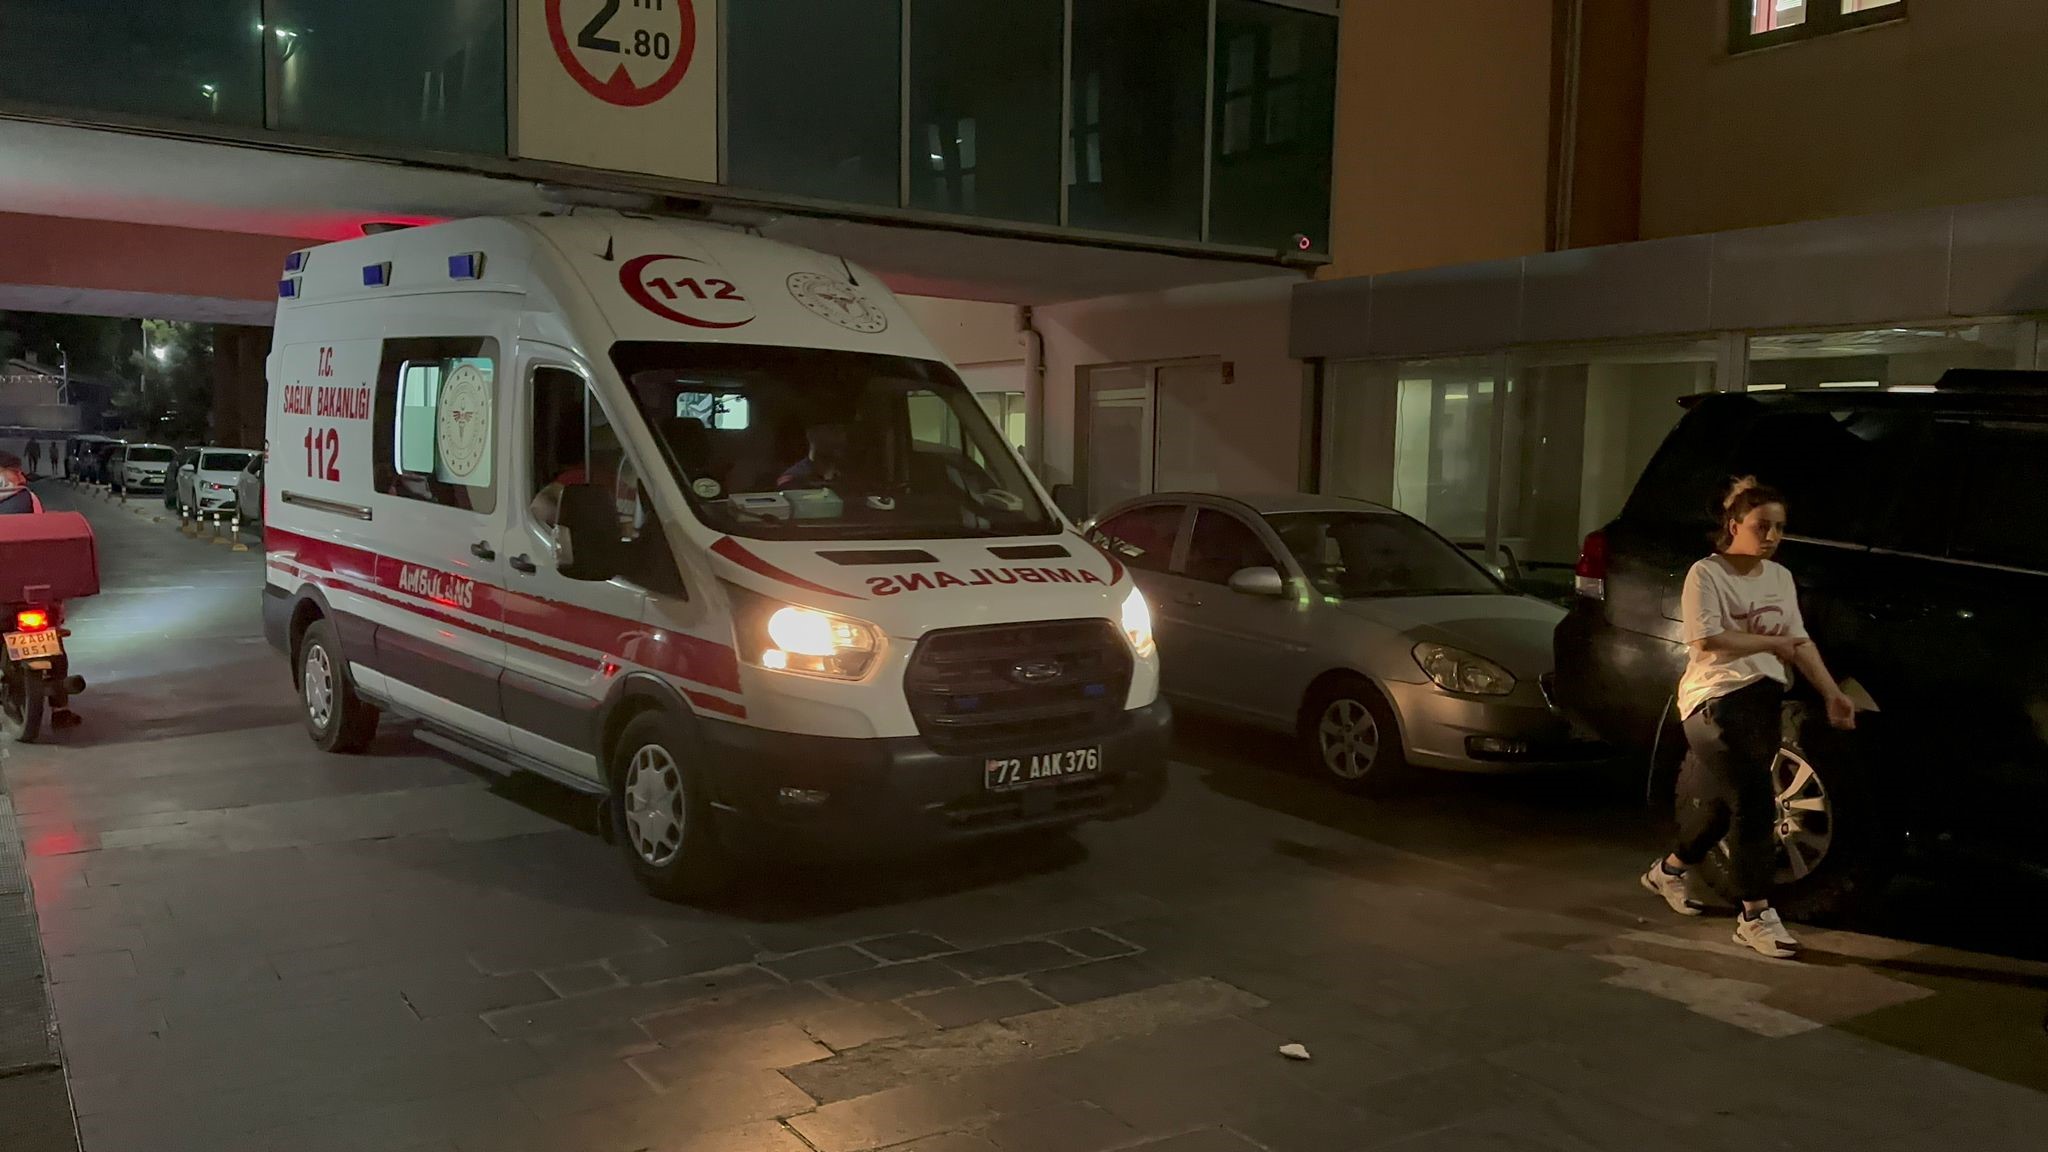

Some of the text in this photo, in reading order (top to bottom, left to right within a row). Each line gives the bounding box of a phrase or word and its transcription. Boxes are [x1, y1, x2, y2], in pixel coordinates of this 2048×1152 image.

[646, 277, 745, 301] 112
[318, 347, 333, 377] T.C.
[283, 380, 371, 420] SAĞLIK BAKANLIĞI
[304, 427, 340, 482] 112
[399, 564, 474, 609] AMBULANS
[997, 748, 1098, 784] 72 AAK 376
